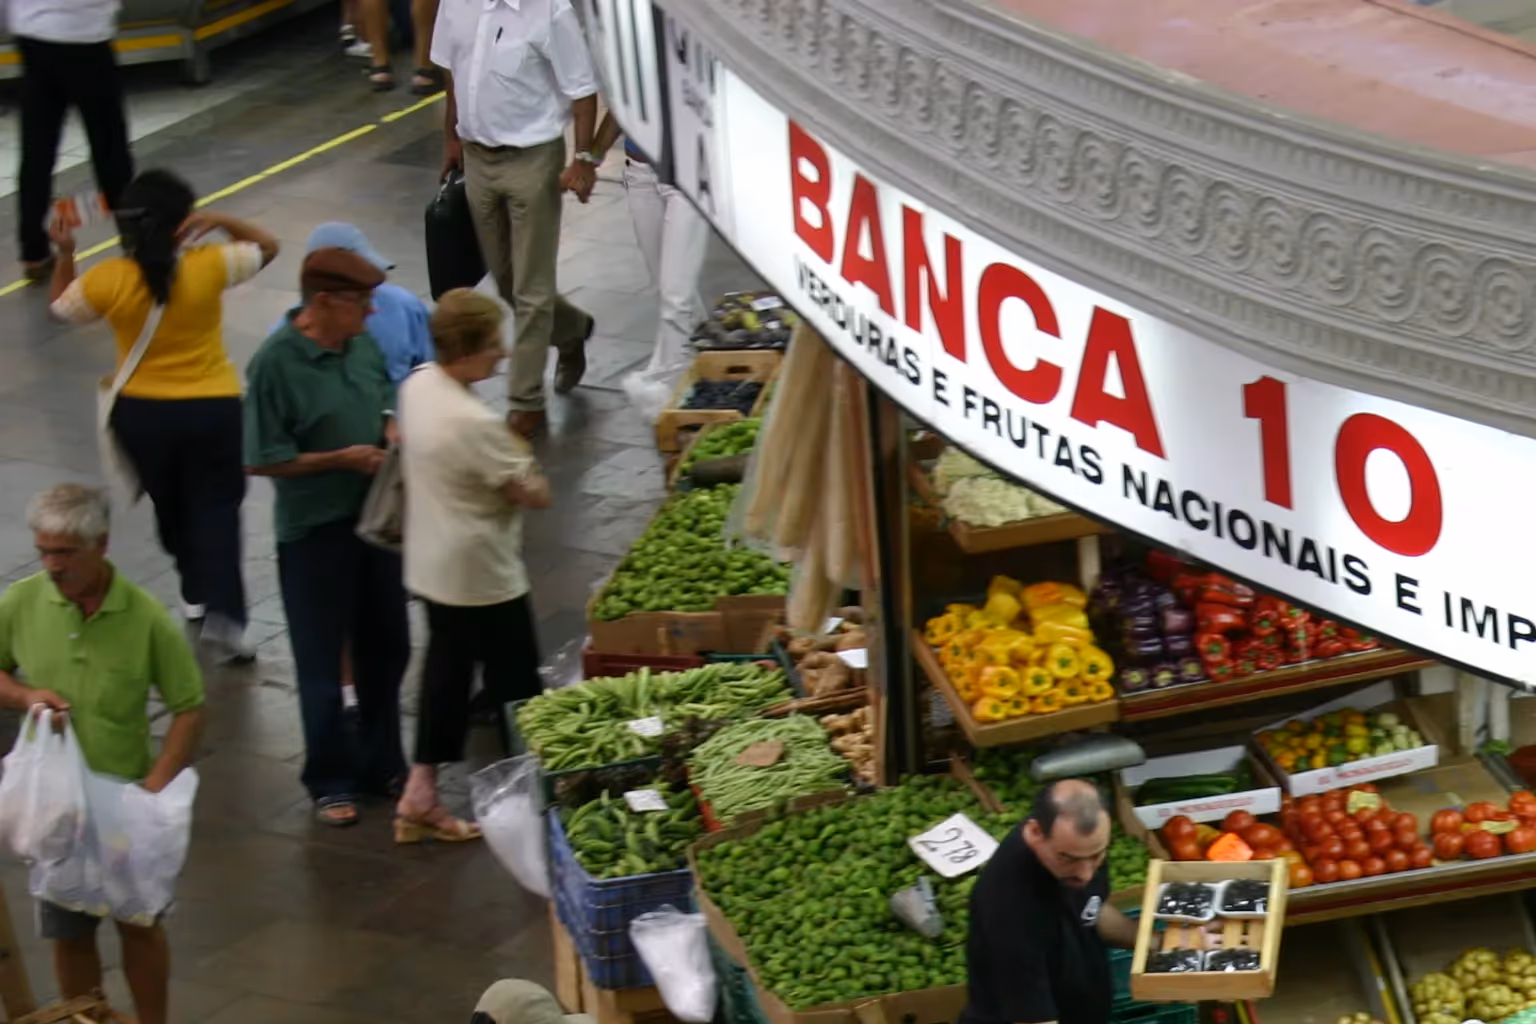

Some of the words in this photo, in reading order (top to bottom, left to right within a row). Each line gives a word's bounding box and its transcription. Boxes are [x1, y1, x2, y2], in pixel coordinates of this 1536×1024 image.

[789, 122, 1165, 458] BANCA
[794, 253, 922, 387] VERDURAS
[932, 367, 950, 407] E
[963, 384, 1103, 485] FRUTAS
[1123, 463, 1373, 596] NACIONAIS
[1396, 573, 1423, 617] E
